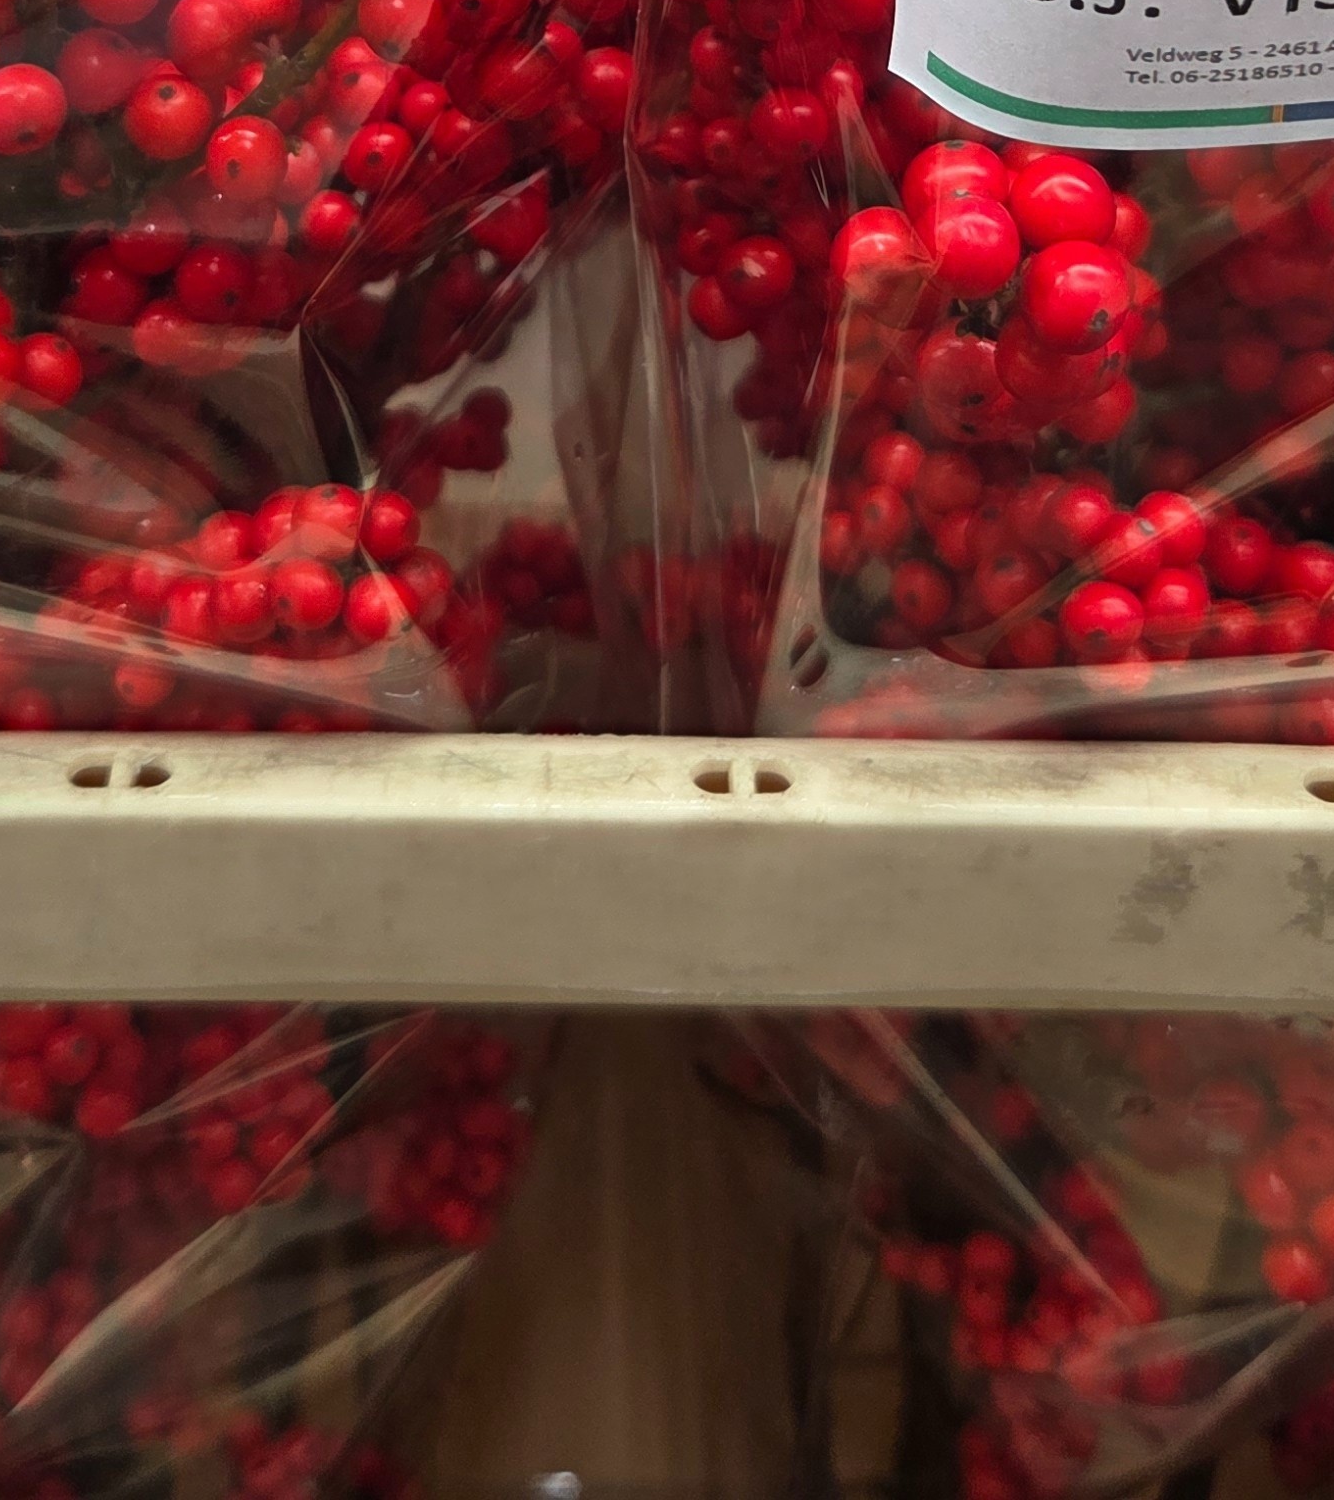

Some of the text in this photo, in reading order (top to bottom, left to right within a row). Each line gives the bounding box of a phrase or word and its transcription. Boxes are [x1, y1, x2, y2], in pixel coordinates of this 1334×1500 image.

[1126, 47, 1224, 64] Veldweg
[1228, 45, 1243, 61] 5
[1263, 41, 1321, 59] 2461
[1125, 69, 1166, 85] Tel.
[1170, 62, 1324, 84] 06-25186510
